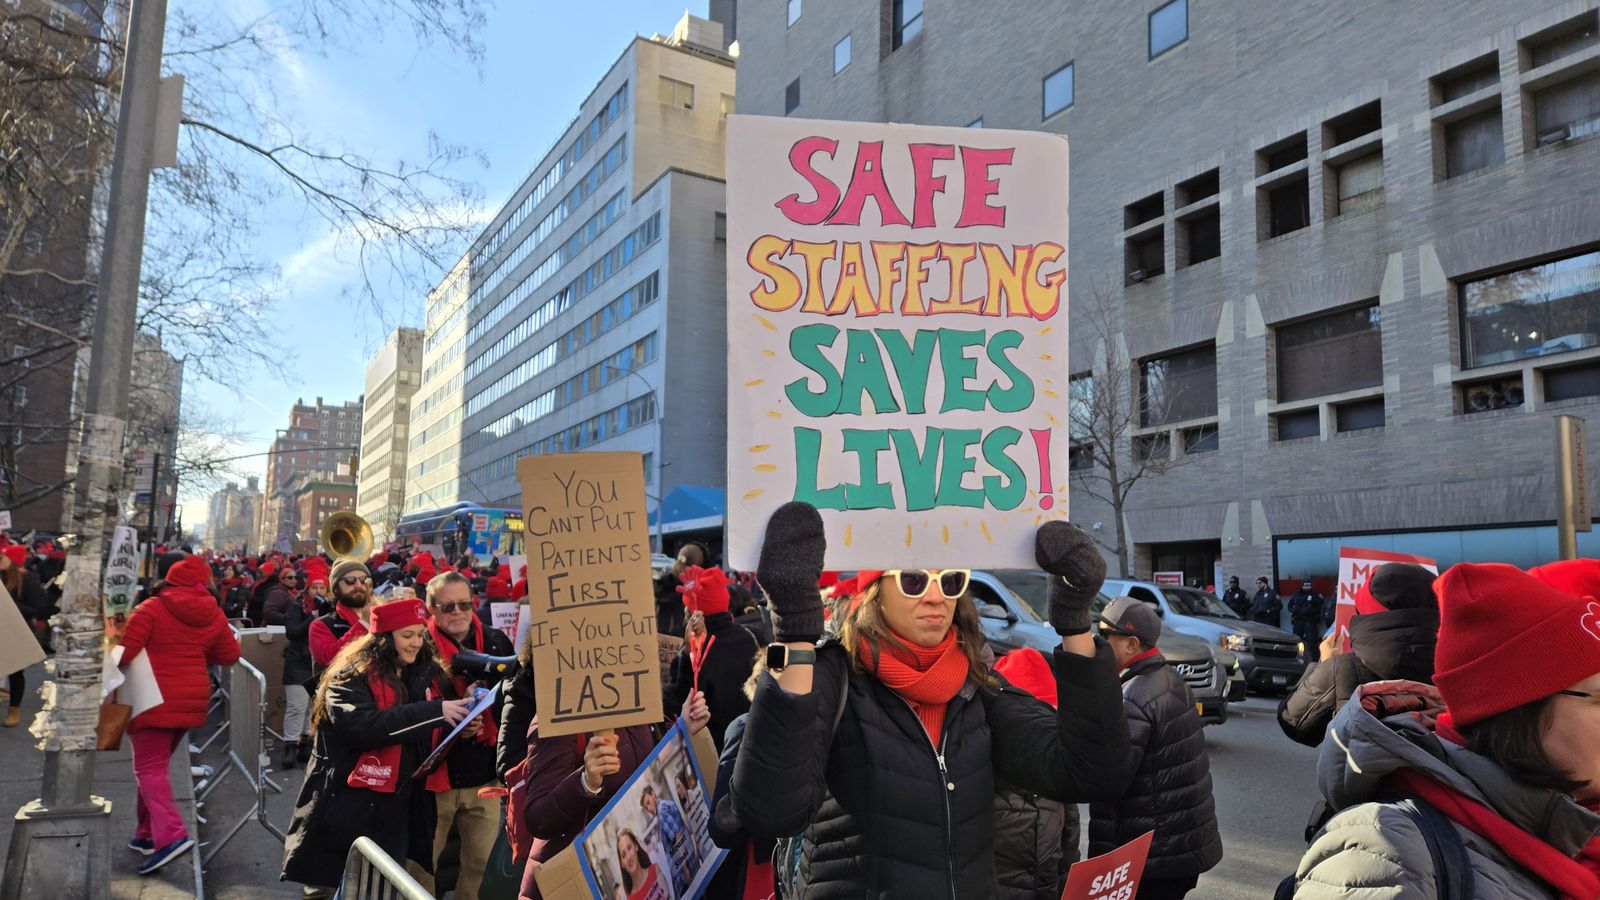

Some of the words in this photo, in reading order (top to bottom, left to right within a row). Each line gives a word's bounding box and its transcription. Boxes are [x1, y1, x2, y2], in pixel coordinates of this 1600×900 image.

[775, 136, 1015, 229] SAFE
[747, 235, 1066, 321] STAFFING
[785, 324, 1034, 417] SAVES
[792, 426, 1055, 511] LIVES!
[1575, 423, 1587, 525] EMERGENCY
[553, 470, 618, 508] YOU
[590, 506, 636, 533] PUT
[541, 541, 642, 570] PATIENTS
[547, 572, 626, 608] FIRST
[531, 620, 560, 648] IF
[557, 644, 645, 673] NURSES
[555, 669, 649, 716] LAST
[1088, 861, 1131, 896] SAFE
